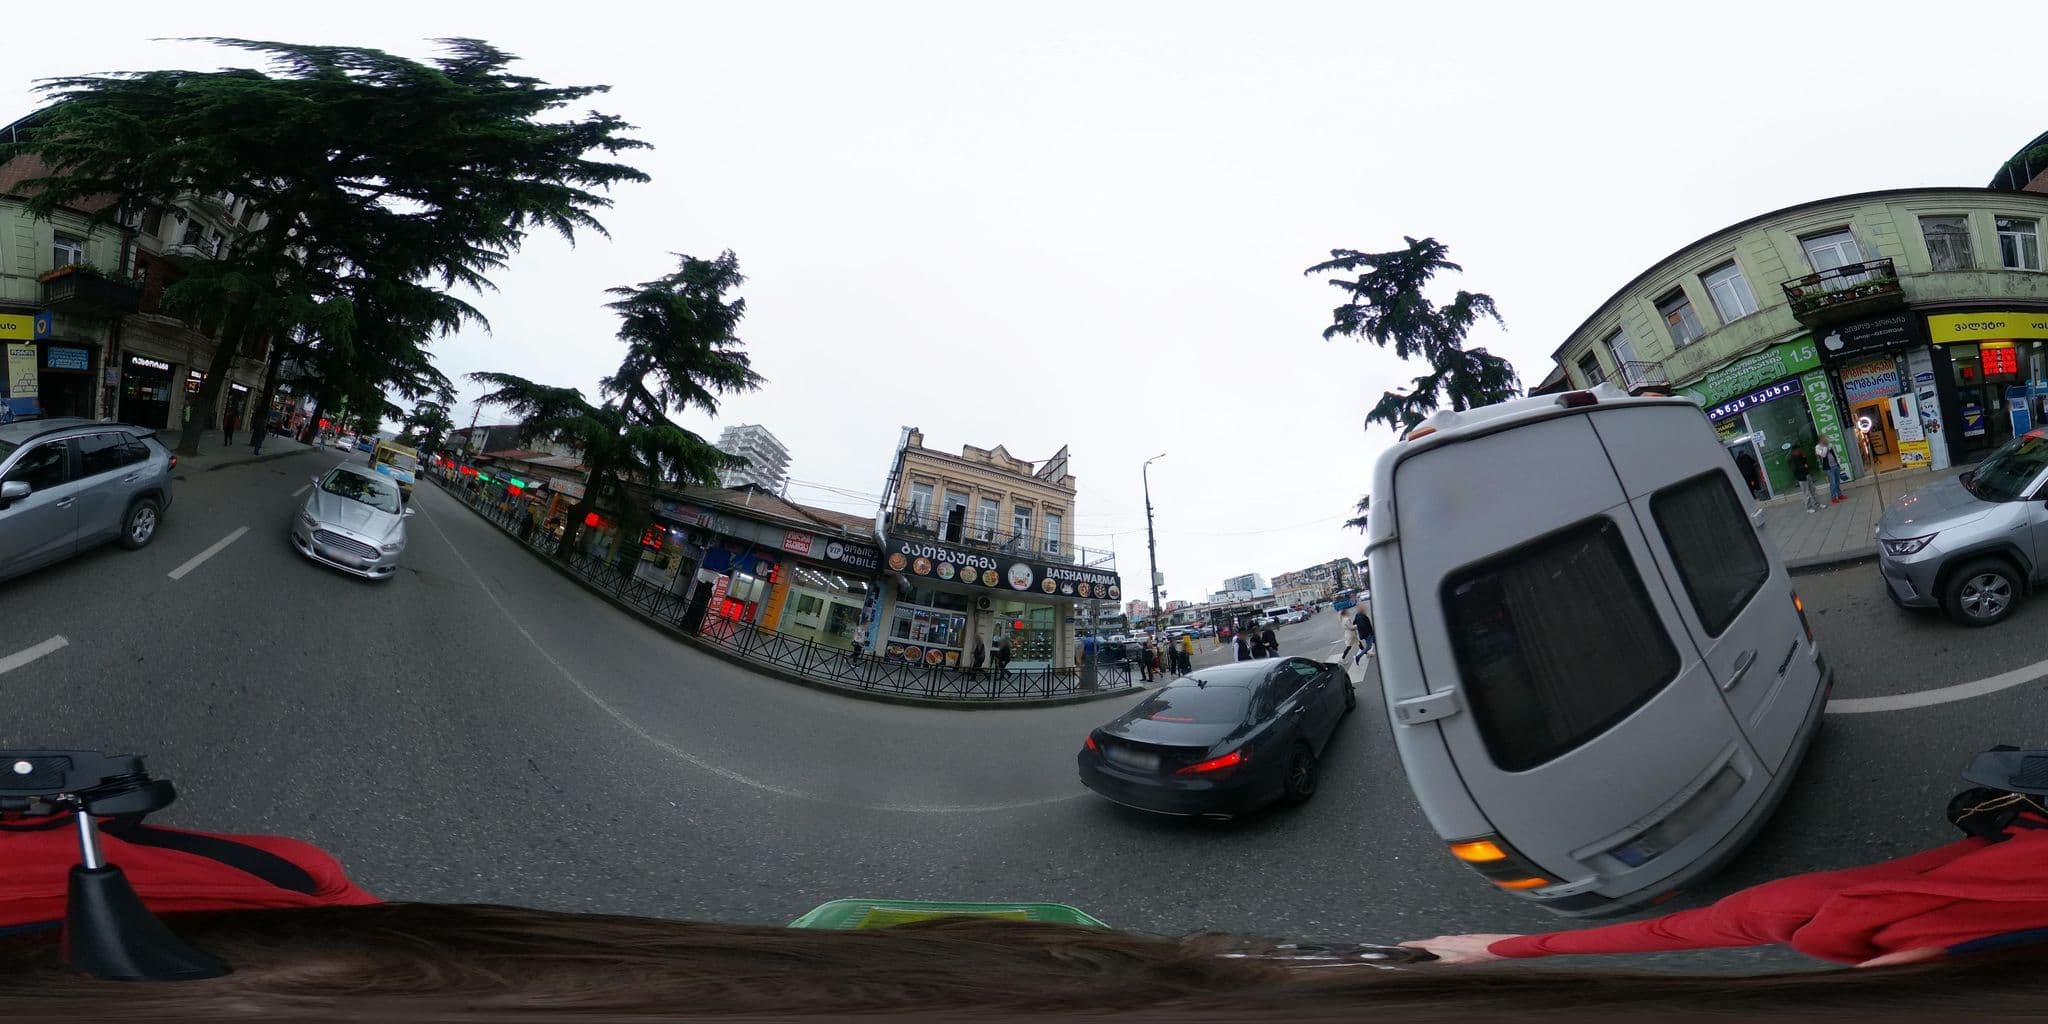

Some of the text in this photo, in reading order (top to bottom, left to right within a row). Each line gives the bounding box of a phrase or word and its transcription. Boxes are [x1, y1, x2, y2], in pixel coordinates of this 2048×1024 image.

[1954, 321, 2006, 332] ვალუტო
[1844, 372, 1897, 390] ლომბარდი
[1710, 384, 1790, 419] იზნეს სესხი
[830, 546, 841, 555] VIP
[901, 542, 998, 570] ბათშაურმა
[841, 553, 878, 569] MOBILE
[1046, 567, 1116, 586] BATSHAWARMA
